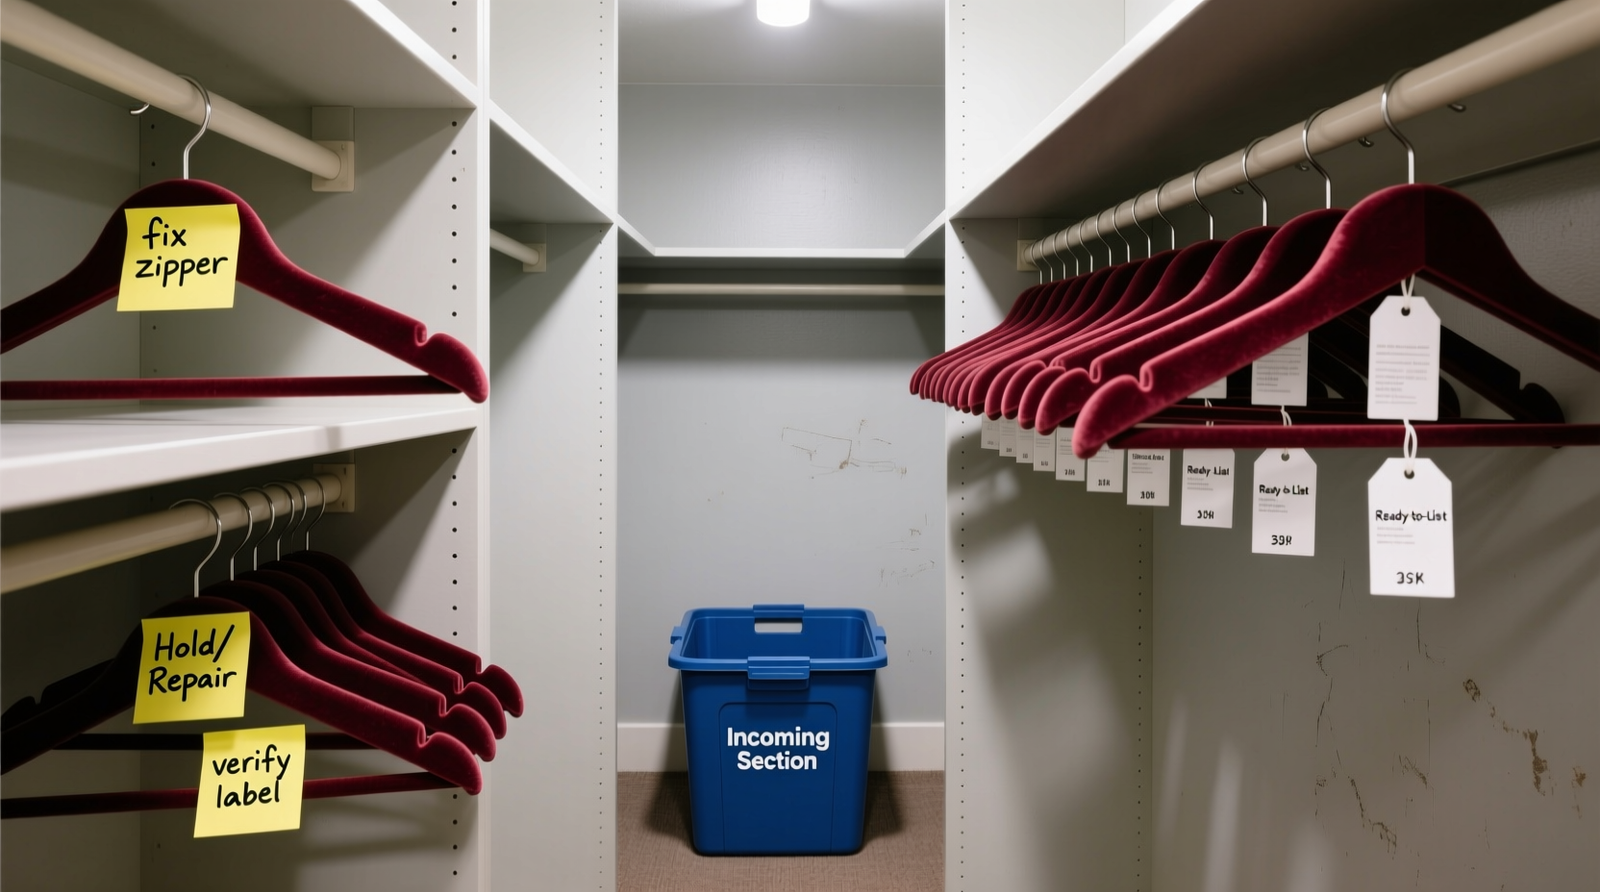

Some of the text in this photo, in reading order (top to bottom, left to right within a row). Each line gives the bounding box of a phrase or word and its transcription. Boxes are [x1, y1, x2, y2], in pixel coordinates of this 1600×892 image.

[142, 216, 187, 250] fix
[135, 255, 229, 288] zipper
[1375, 508, 1409, 524] Ready
[154, 624, 235, 663] Hold/
[148, 666, 237, 702] Repair
[727, 726, 830, 751] Incoming
[212, 744, 291, 781] verify
[737, 750, 818, 770] Section
[217, 779, 280, 808] label
